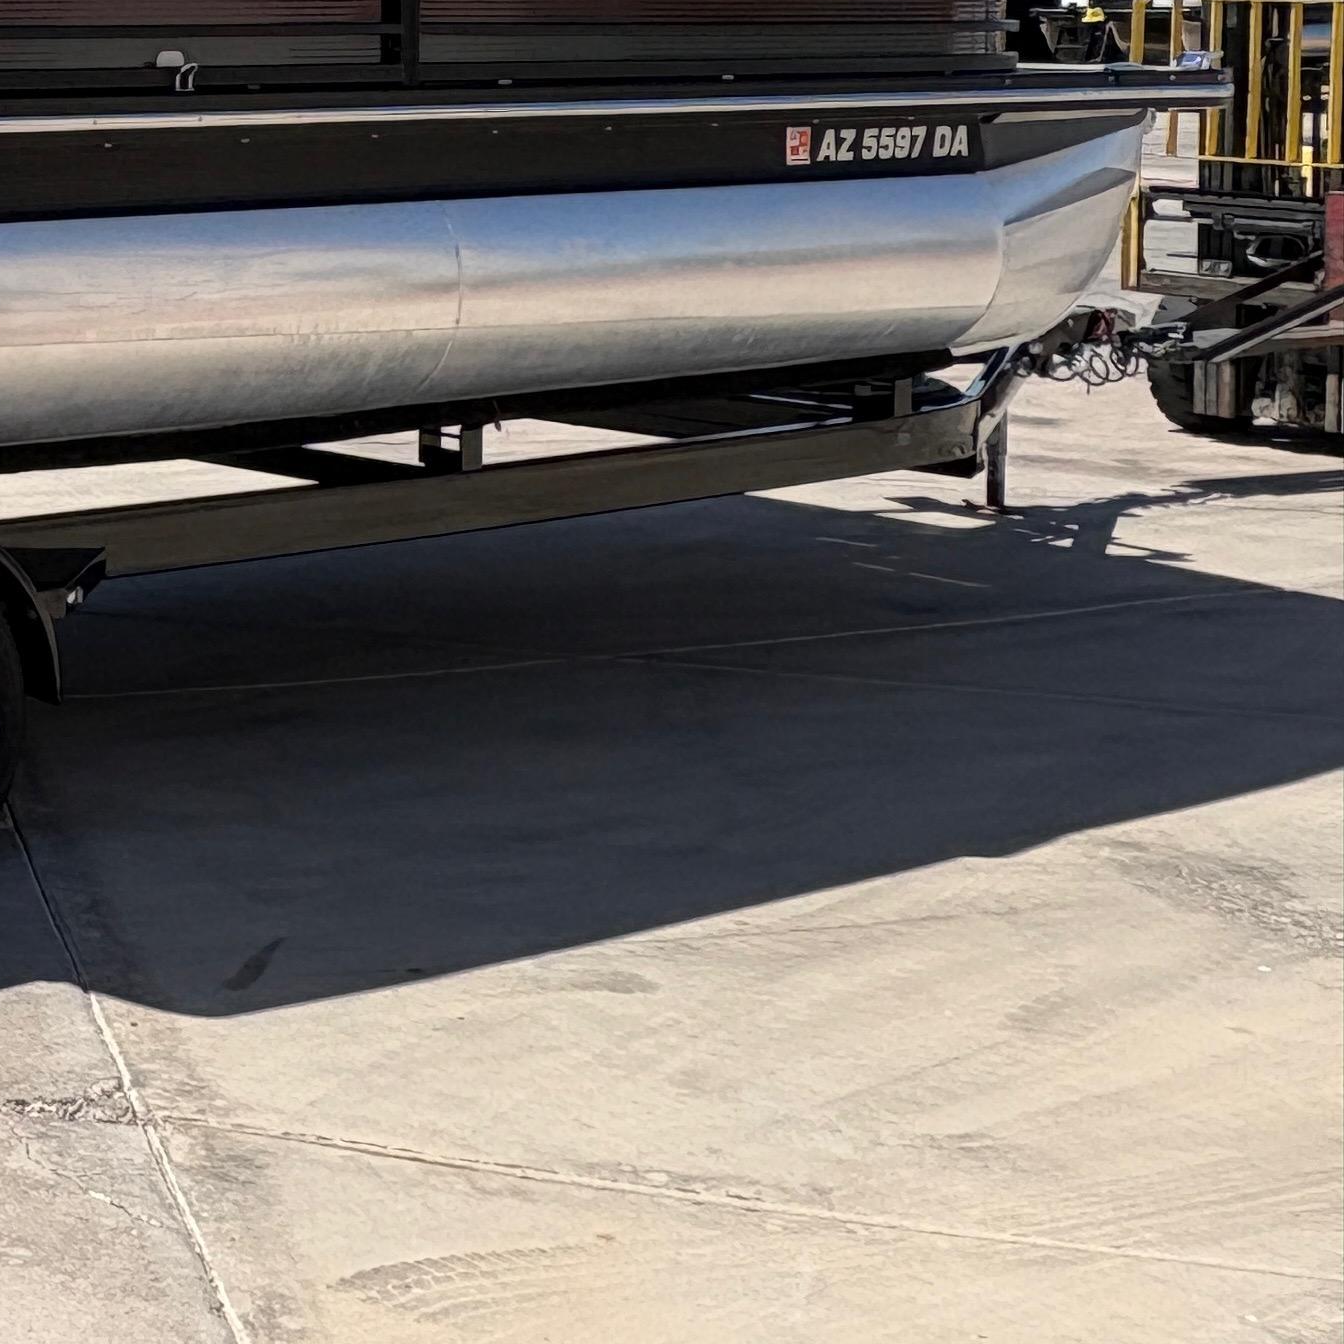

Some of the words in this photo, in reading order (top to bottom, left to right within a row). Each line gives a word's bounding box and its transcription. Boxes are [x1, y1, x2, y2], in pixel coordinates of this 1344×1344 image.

[816, 128, 857, 162] AZ
[861, 125, 928, 160] 5597
[932, 124, 969, 158] DA
